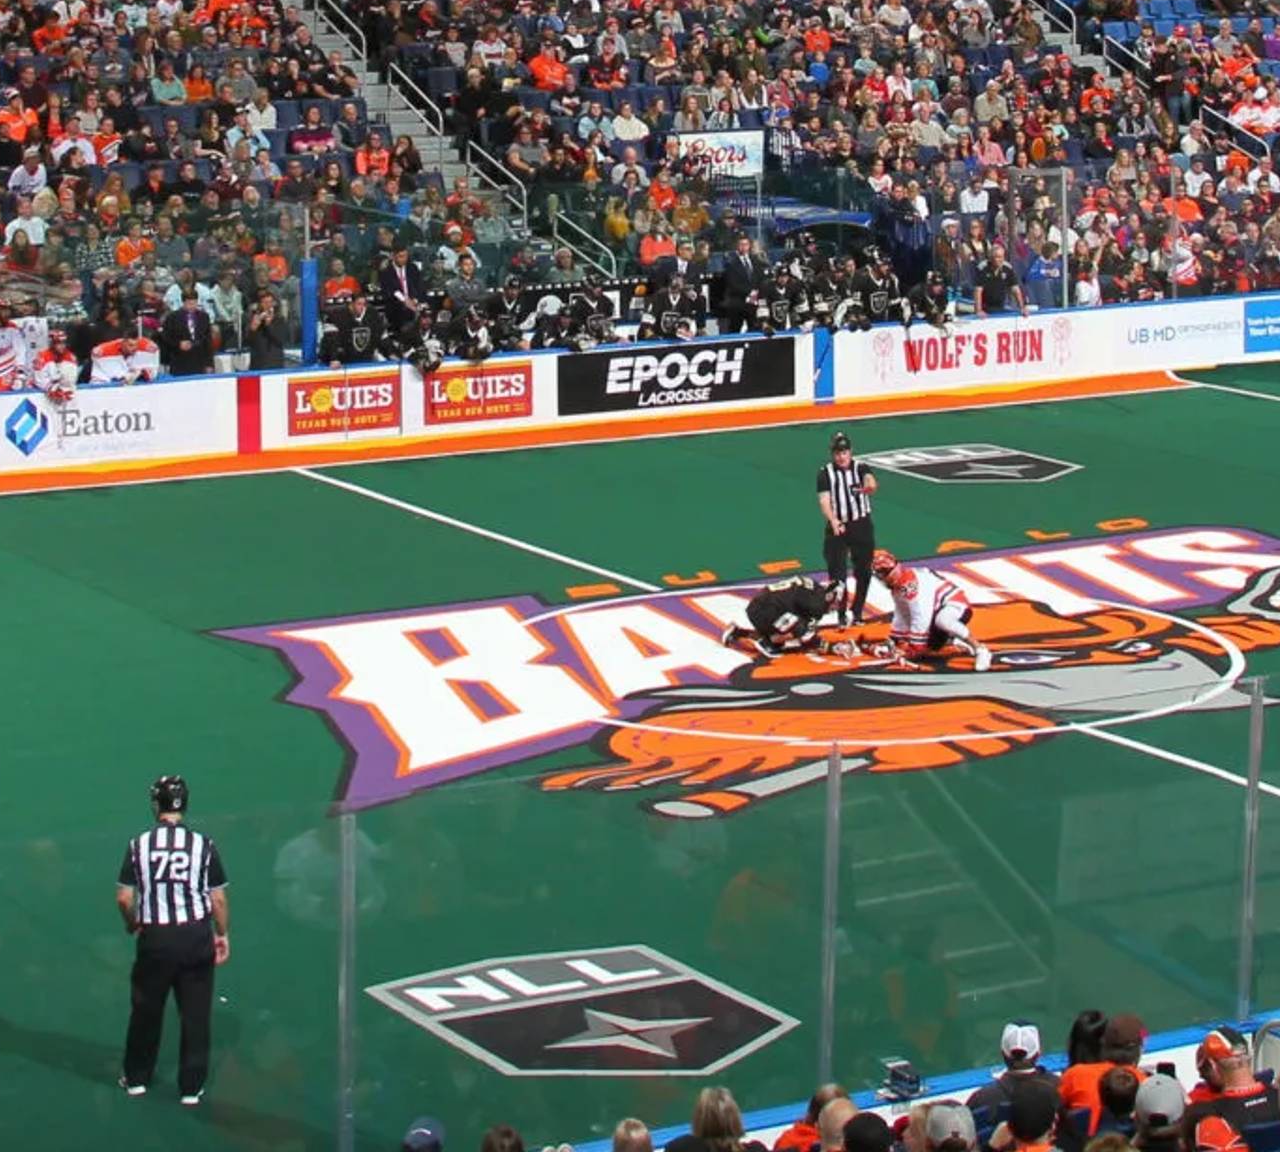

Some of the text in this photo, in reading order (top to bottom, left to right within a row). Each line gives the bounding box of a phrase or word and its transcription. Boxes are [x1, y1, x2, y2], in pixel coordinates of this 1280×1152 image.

[1127, 327, 1149, 344] UB
[1154, 326, 1176, 342] MD
[903, 329, 1044, 373] WOLF'S RUN
[606, 347, 744, 394] EPOCH
[637, 387, 712, 407] LACROSSE
[59, 409, 155, 438] Eaton
[150, 850, 190, 881] 72
[403, 959, 661, 1011] NLL
